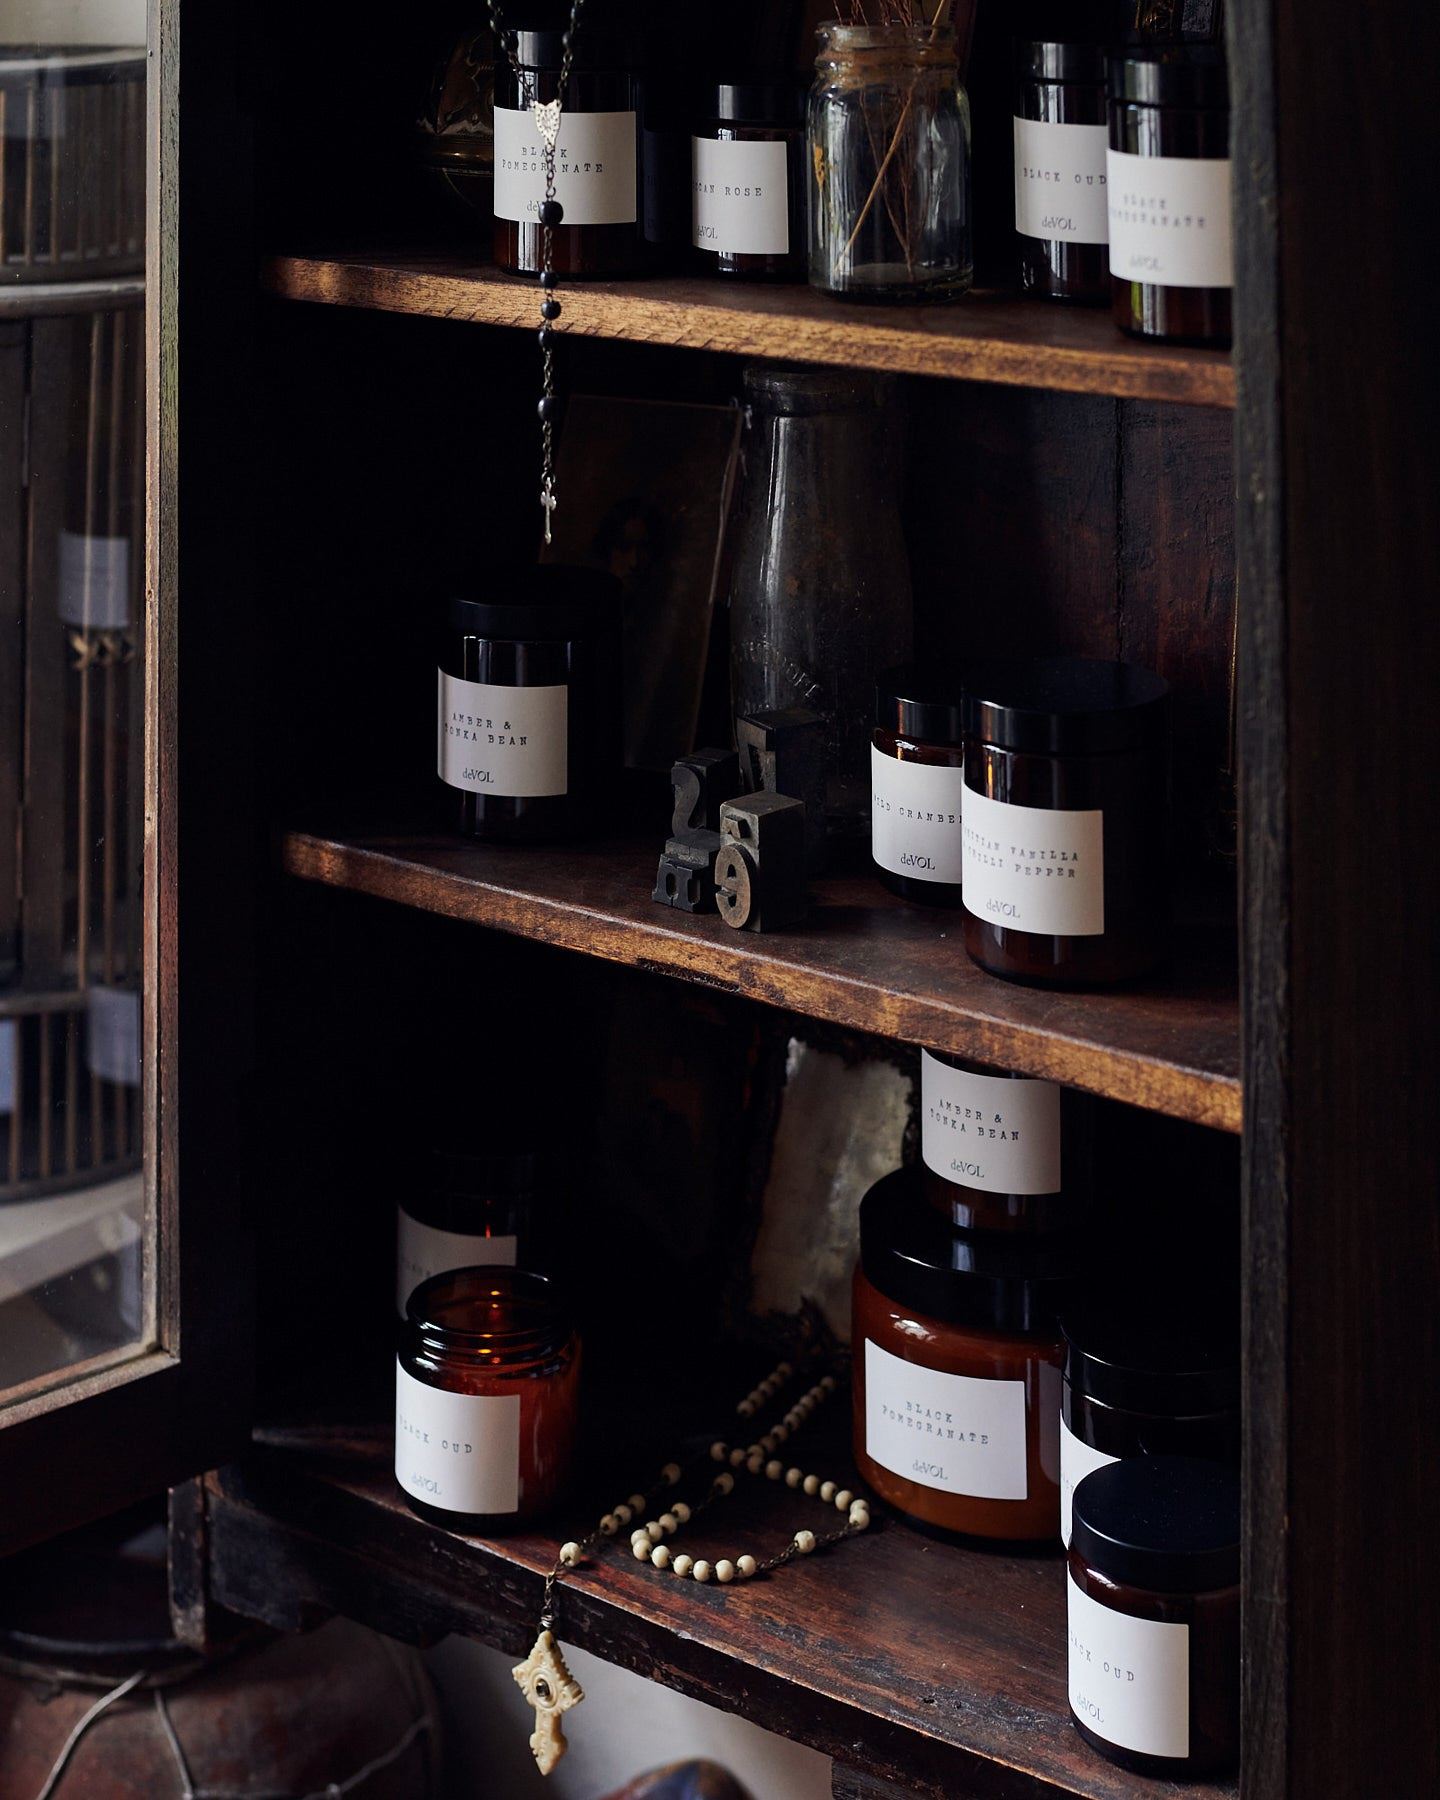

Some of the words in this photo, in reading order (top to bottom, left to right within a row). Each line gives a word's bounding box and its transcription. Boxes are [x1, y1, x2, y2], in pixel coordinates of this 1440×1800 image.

[1023, 167, 1061, 182] BLACK
[1074, 174, 1107, 185] OUD
[725, 187, 762, 197] ROSE
[452, 712, 493, 729] AMBER
[504, 721, 511, 730] &
[488, 735, 528, 746] BEAN
[462, 767, 494, 783] deVOL
[899, 806, 962, 824] CRANBE
[900, 853, 936, 870] deVOL
[1010, 846, 1078, 861] VANILLA
[1015, 863, 1075, 878] PEPPER
[986, 898, 1020, 918] deVOL
[939, 1099, 982, 1120] AMBER
[994, 1114, 1002, 1123] &
[930, 1108, 966, 1133] TONKA
[978, 1126, 1019, 1141] BEAN
[950, 1159, 984, 1178] deVOL
[906, 1401, 953, 1423] BLACK
[882, 1405, 989, 1445] POMEGRANATE
[442, 1440, 472, 1454] OUD
[912, 1459, 948, 1480] deVOL
[1103, 1661, 1135, 1682] OUD
